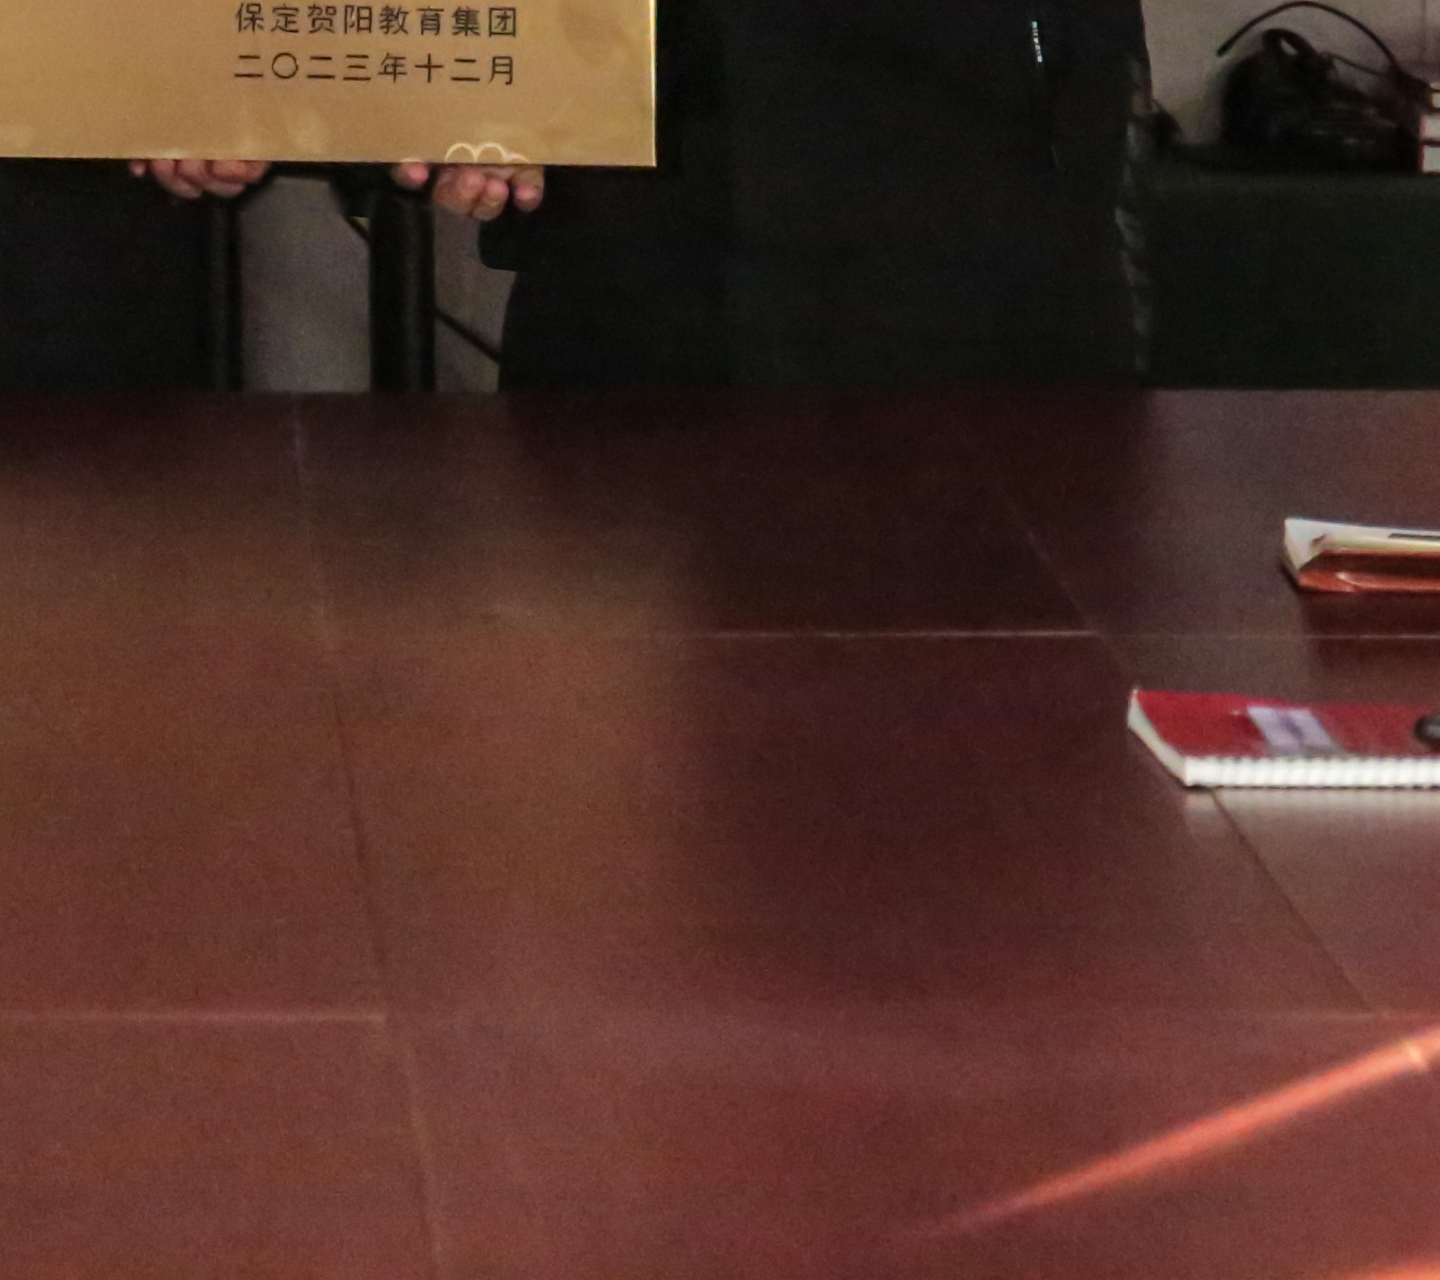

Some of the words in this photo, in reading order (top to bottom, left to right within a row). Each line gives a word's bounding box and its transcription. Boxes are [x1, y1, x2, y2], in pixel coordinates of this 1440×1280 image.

[234, 2, 519, 39] 保定贺阳教育集团
